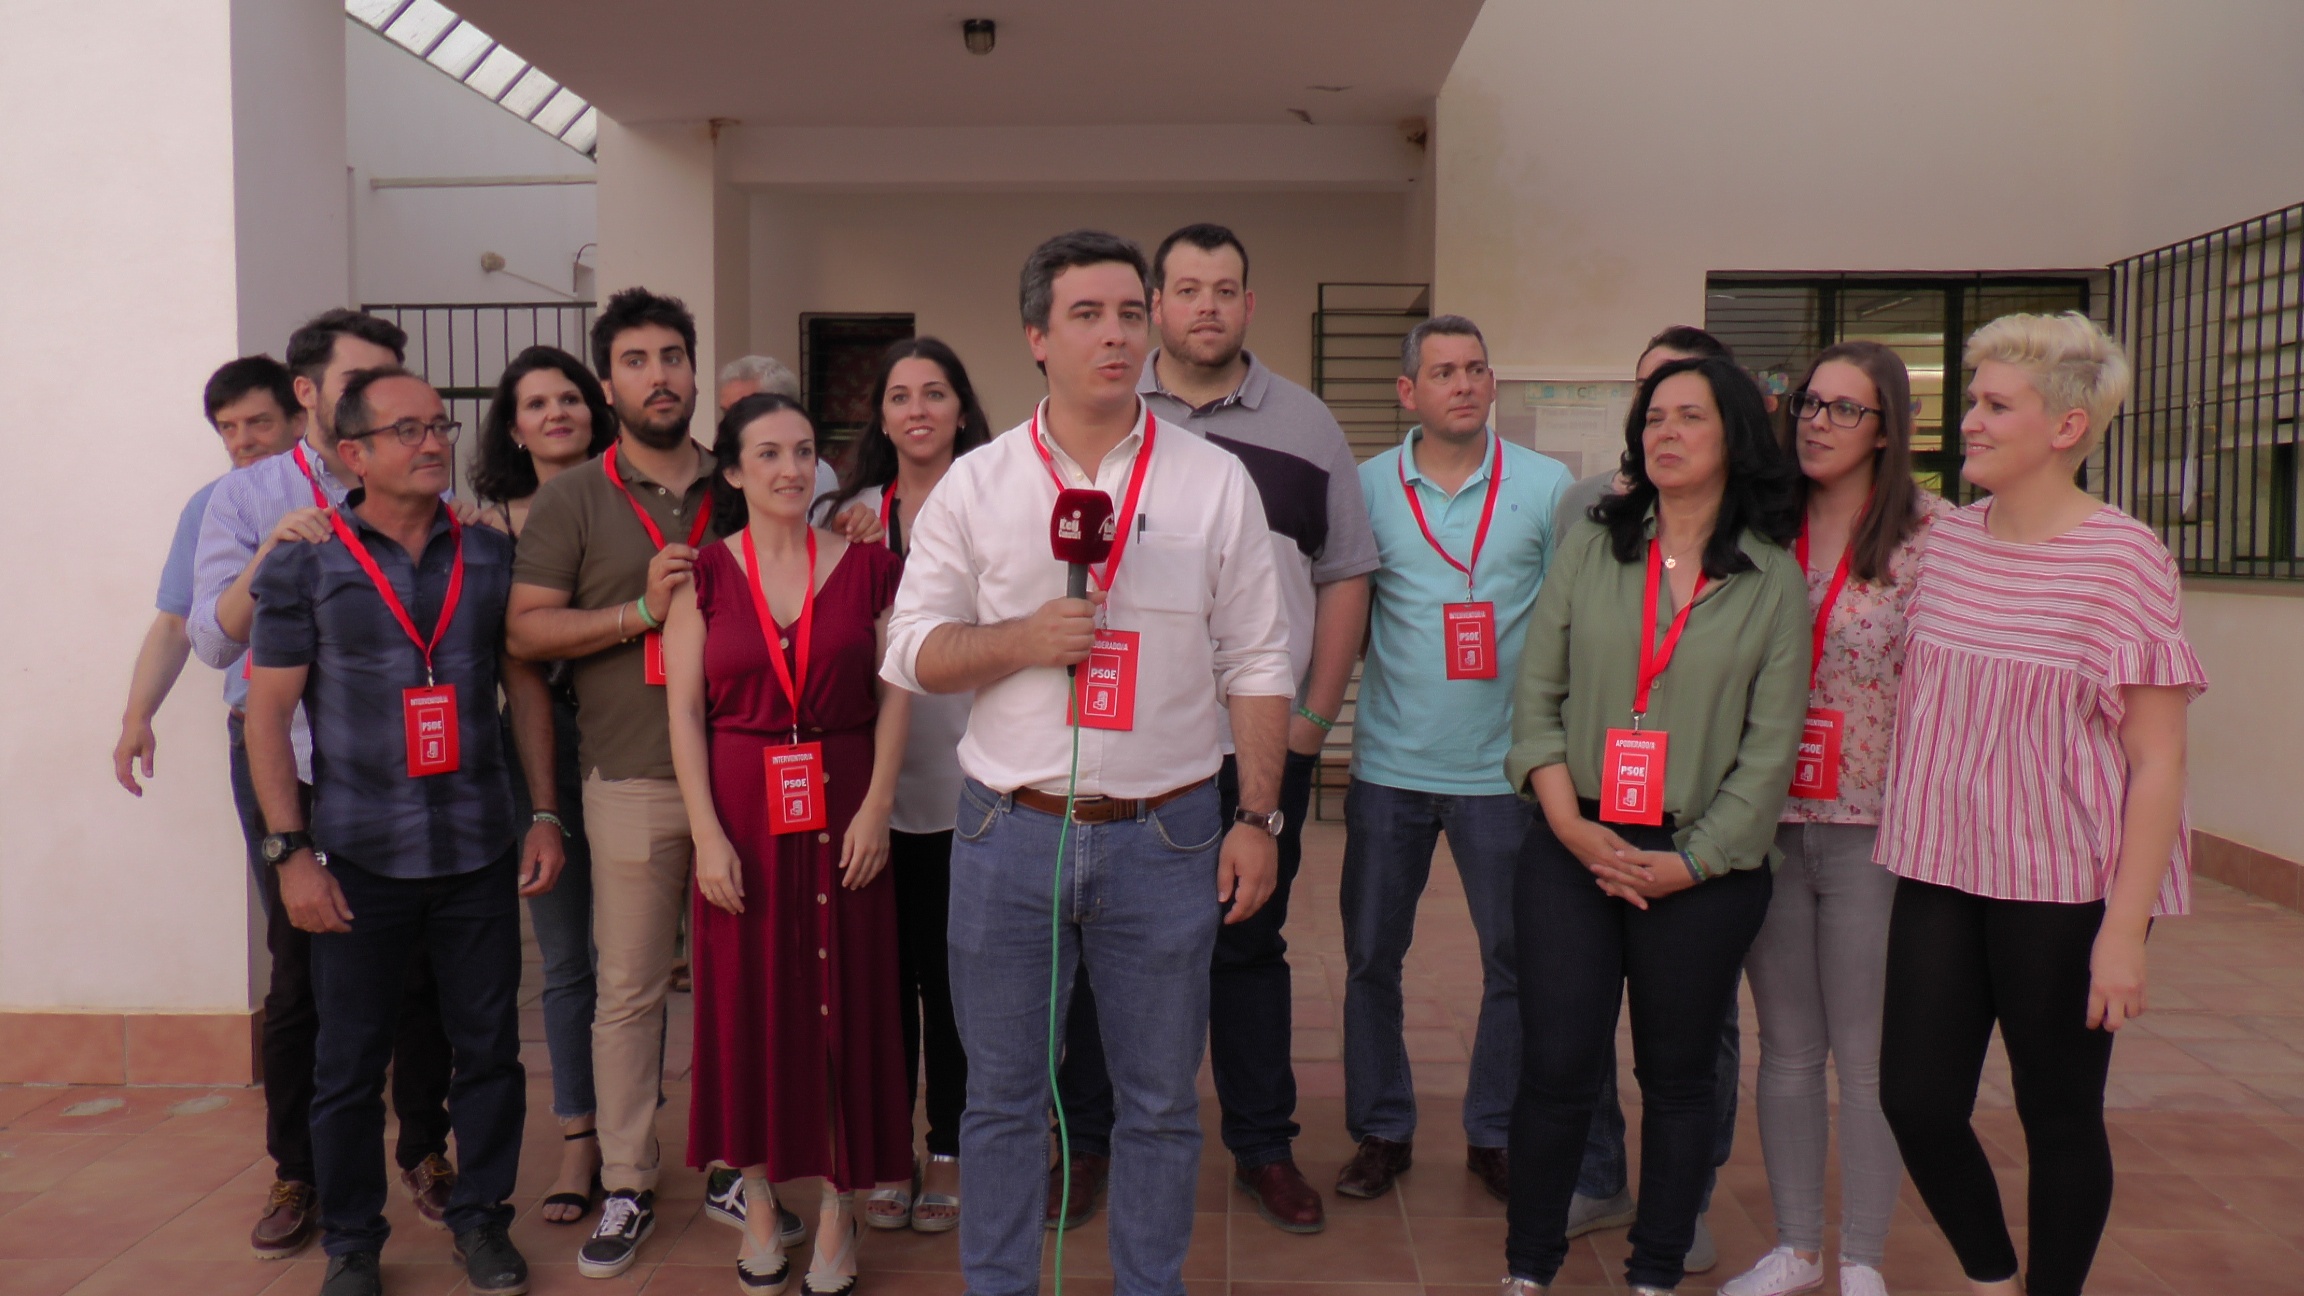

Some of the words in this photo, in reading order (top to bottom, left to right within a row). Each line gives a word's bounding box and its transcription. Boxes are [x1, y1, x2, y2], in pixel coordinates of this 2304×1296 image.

[1458, 631, 1480, 642] PSOE
[1090, 668, 1117, 680] PSOE
[422, 720, 443, 732] PSOE
[1798, 742, 1823, 755] PSOE
[1620, 765, 1646, 778] PSOE
[783, 778, 808, 790] PSOE
